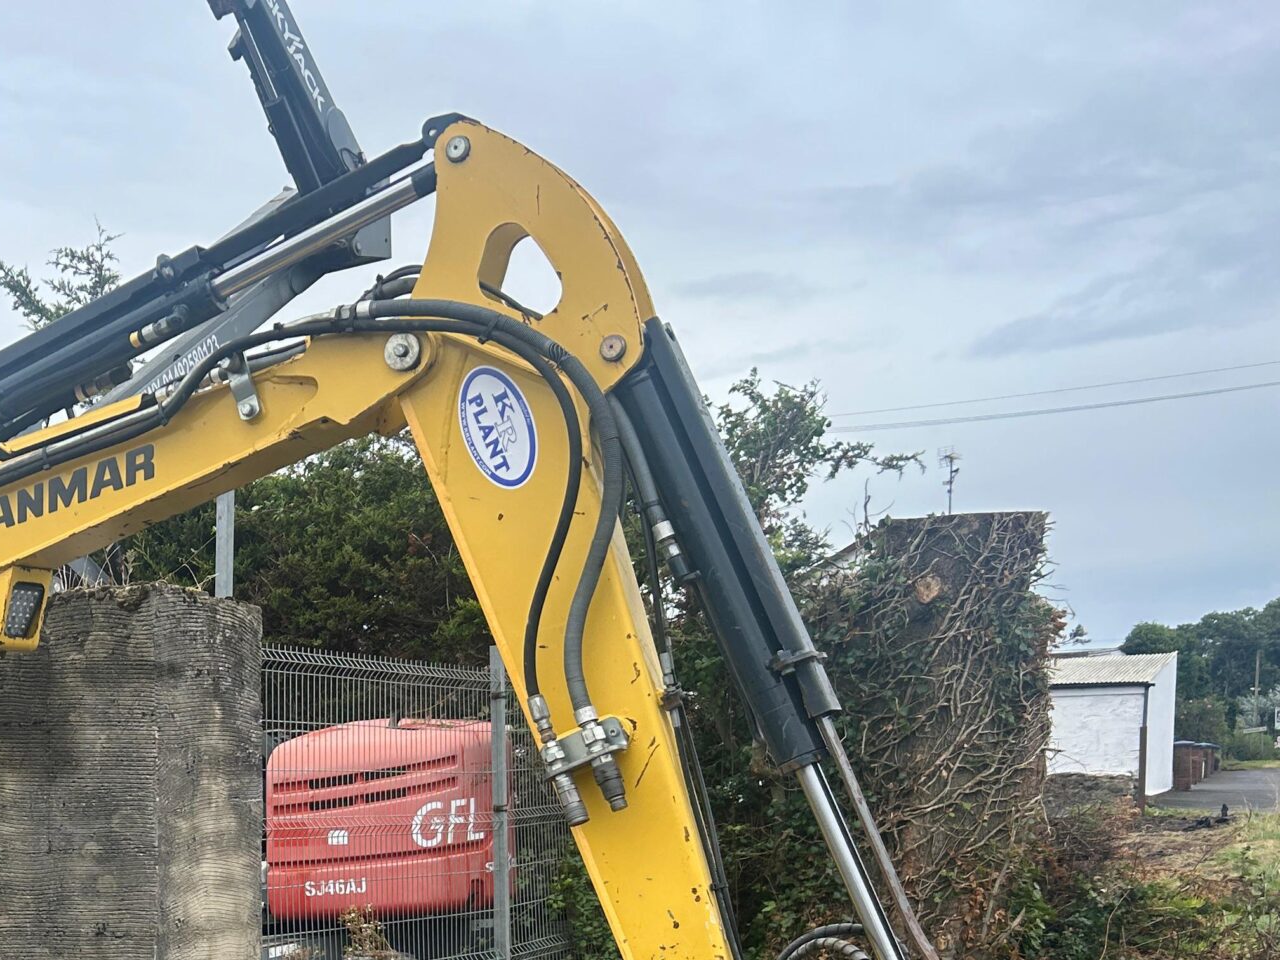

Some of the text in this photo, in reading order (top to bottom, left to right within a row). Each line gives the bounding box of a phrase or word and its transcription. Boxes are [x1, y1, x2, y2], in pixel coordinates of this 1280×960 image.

[467, 392, 511, 473] PLANT
[411, 797, 484, 848] GFL
[305, 877, 367, 897] SJ46AJ
